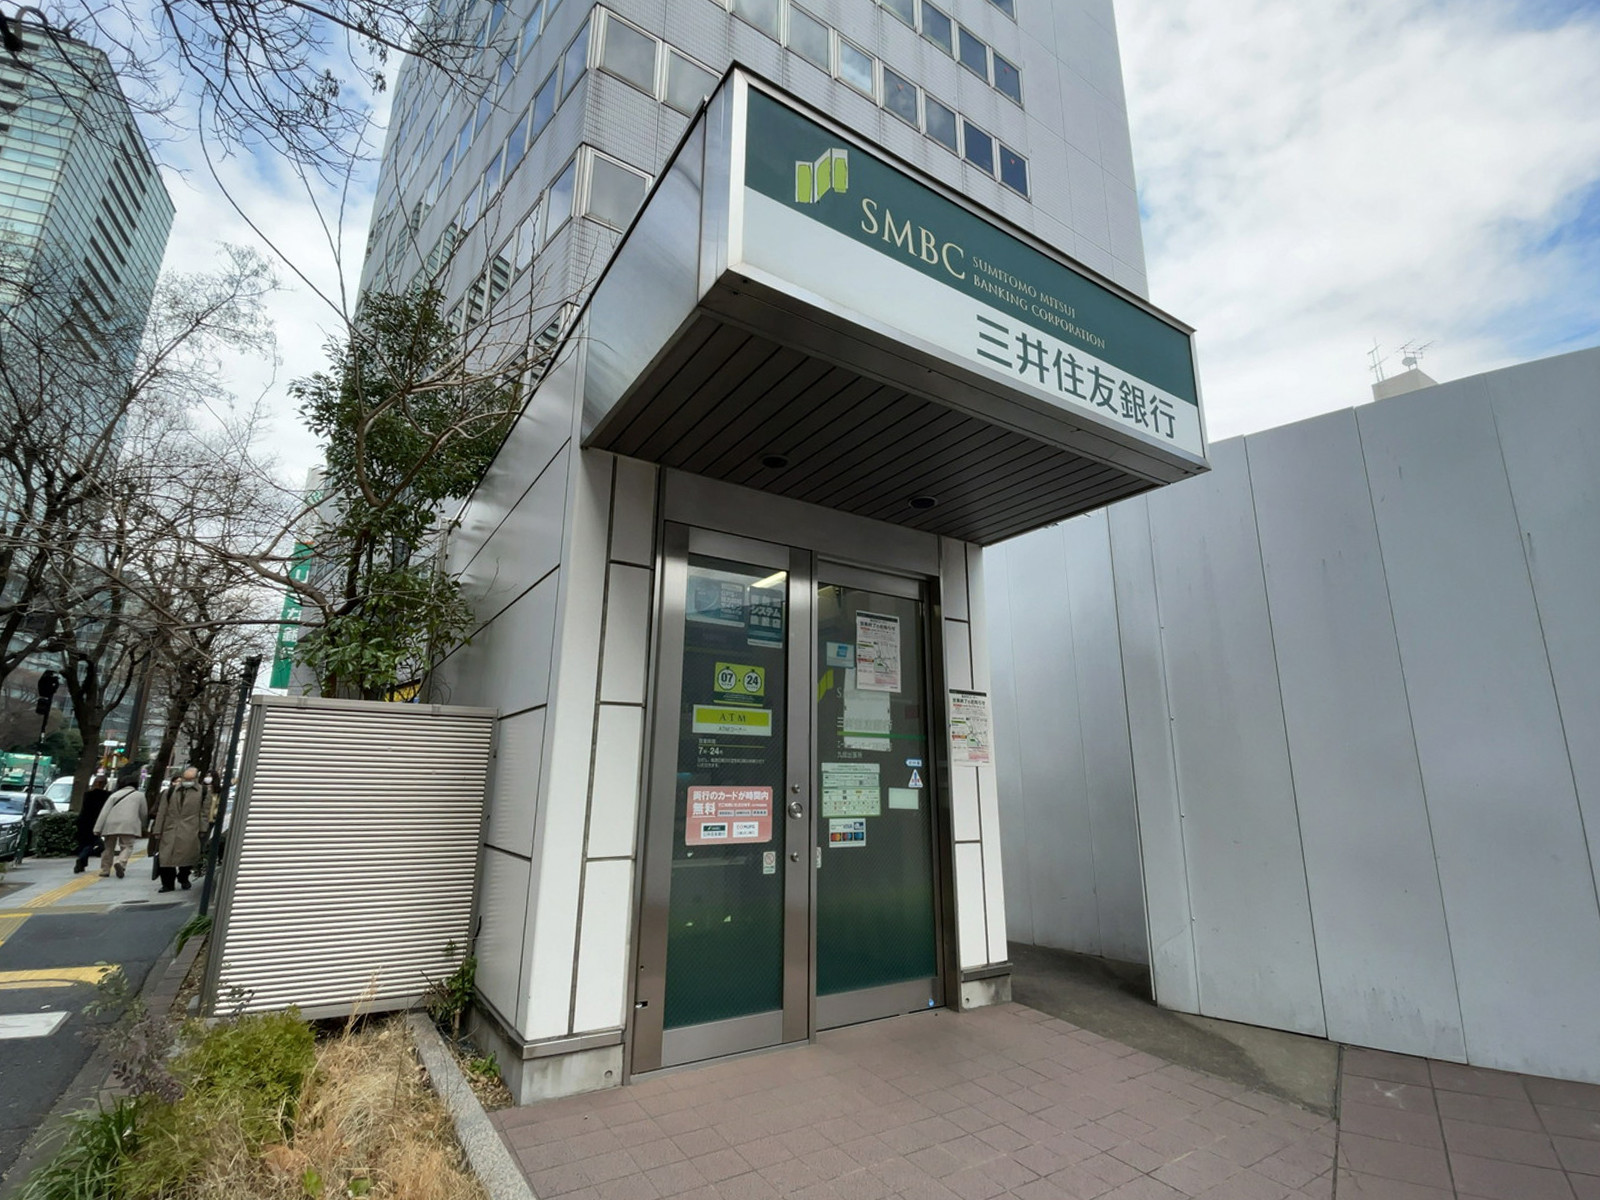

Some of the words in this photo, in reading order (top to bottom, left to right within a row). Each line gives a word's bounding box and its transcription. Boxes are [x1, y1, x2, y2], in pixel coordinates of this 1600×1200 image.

[861, 198, 965, 280] SMBC
[973, 256, 1037, 298] SUMITOMO
[1040, 292, 1076, 319] MITSUI
[973, 274, 1028, 311] BANKING
[1031, 304, 1106, 350] CORPORATION
[976, 314, 1176, 439] 三井住友銀行
[721, 672, 733, 683] 07
[746, 675, 759, 685] 24
[719, 713, 746, 722] ATM
[692, 802, 716, 815] 無料
